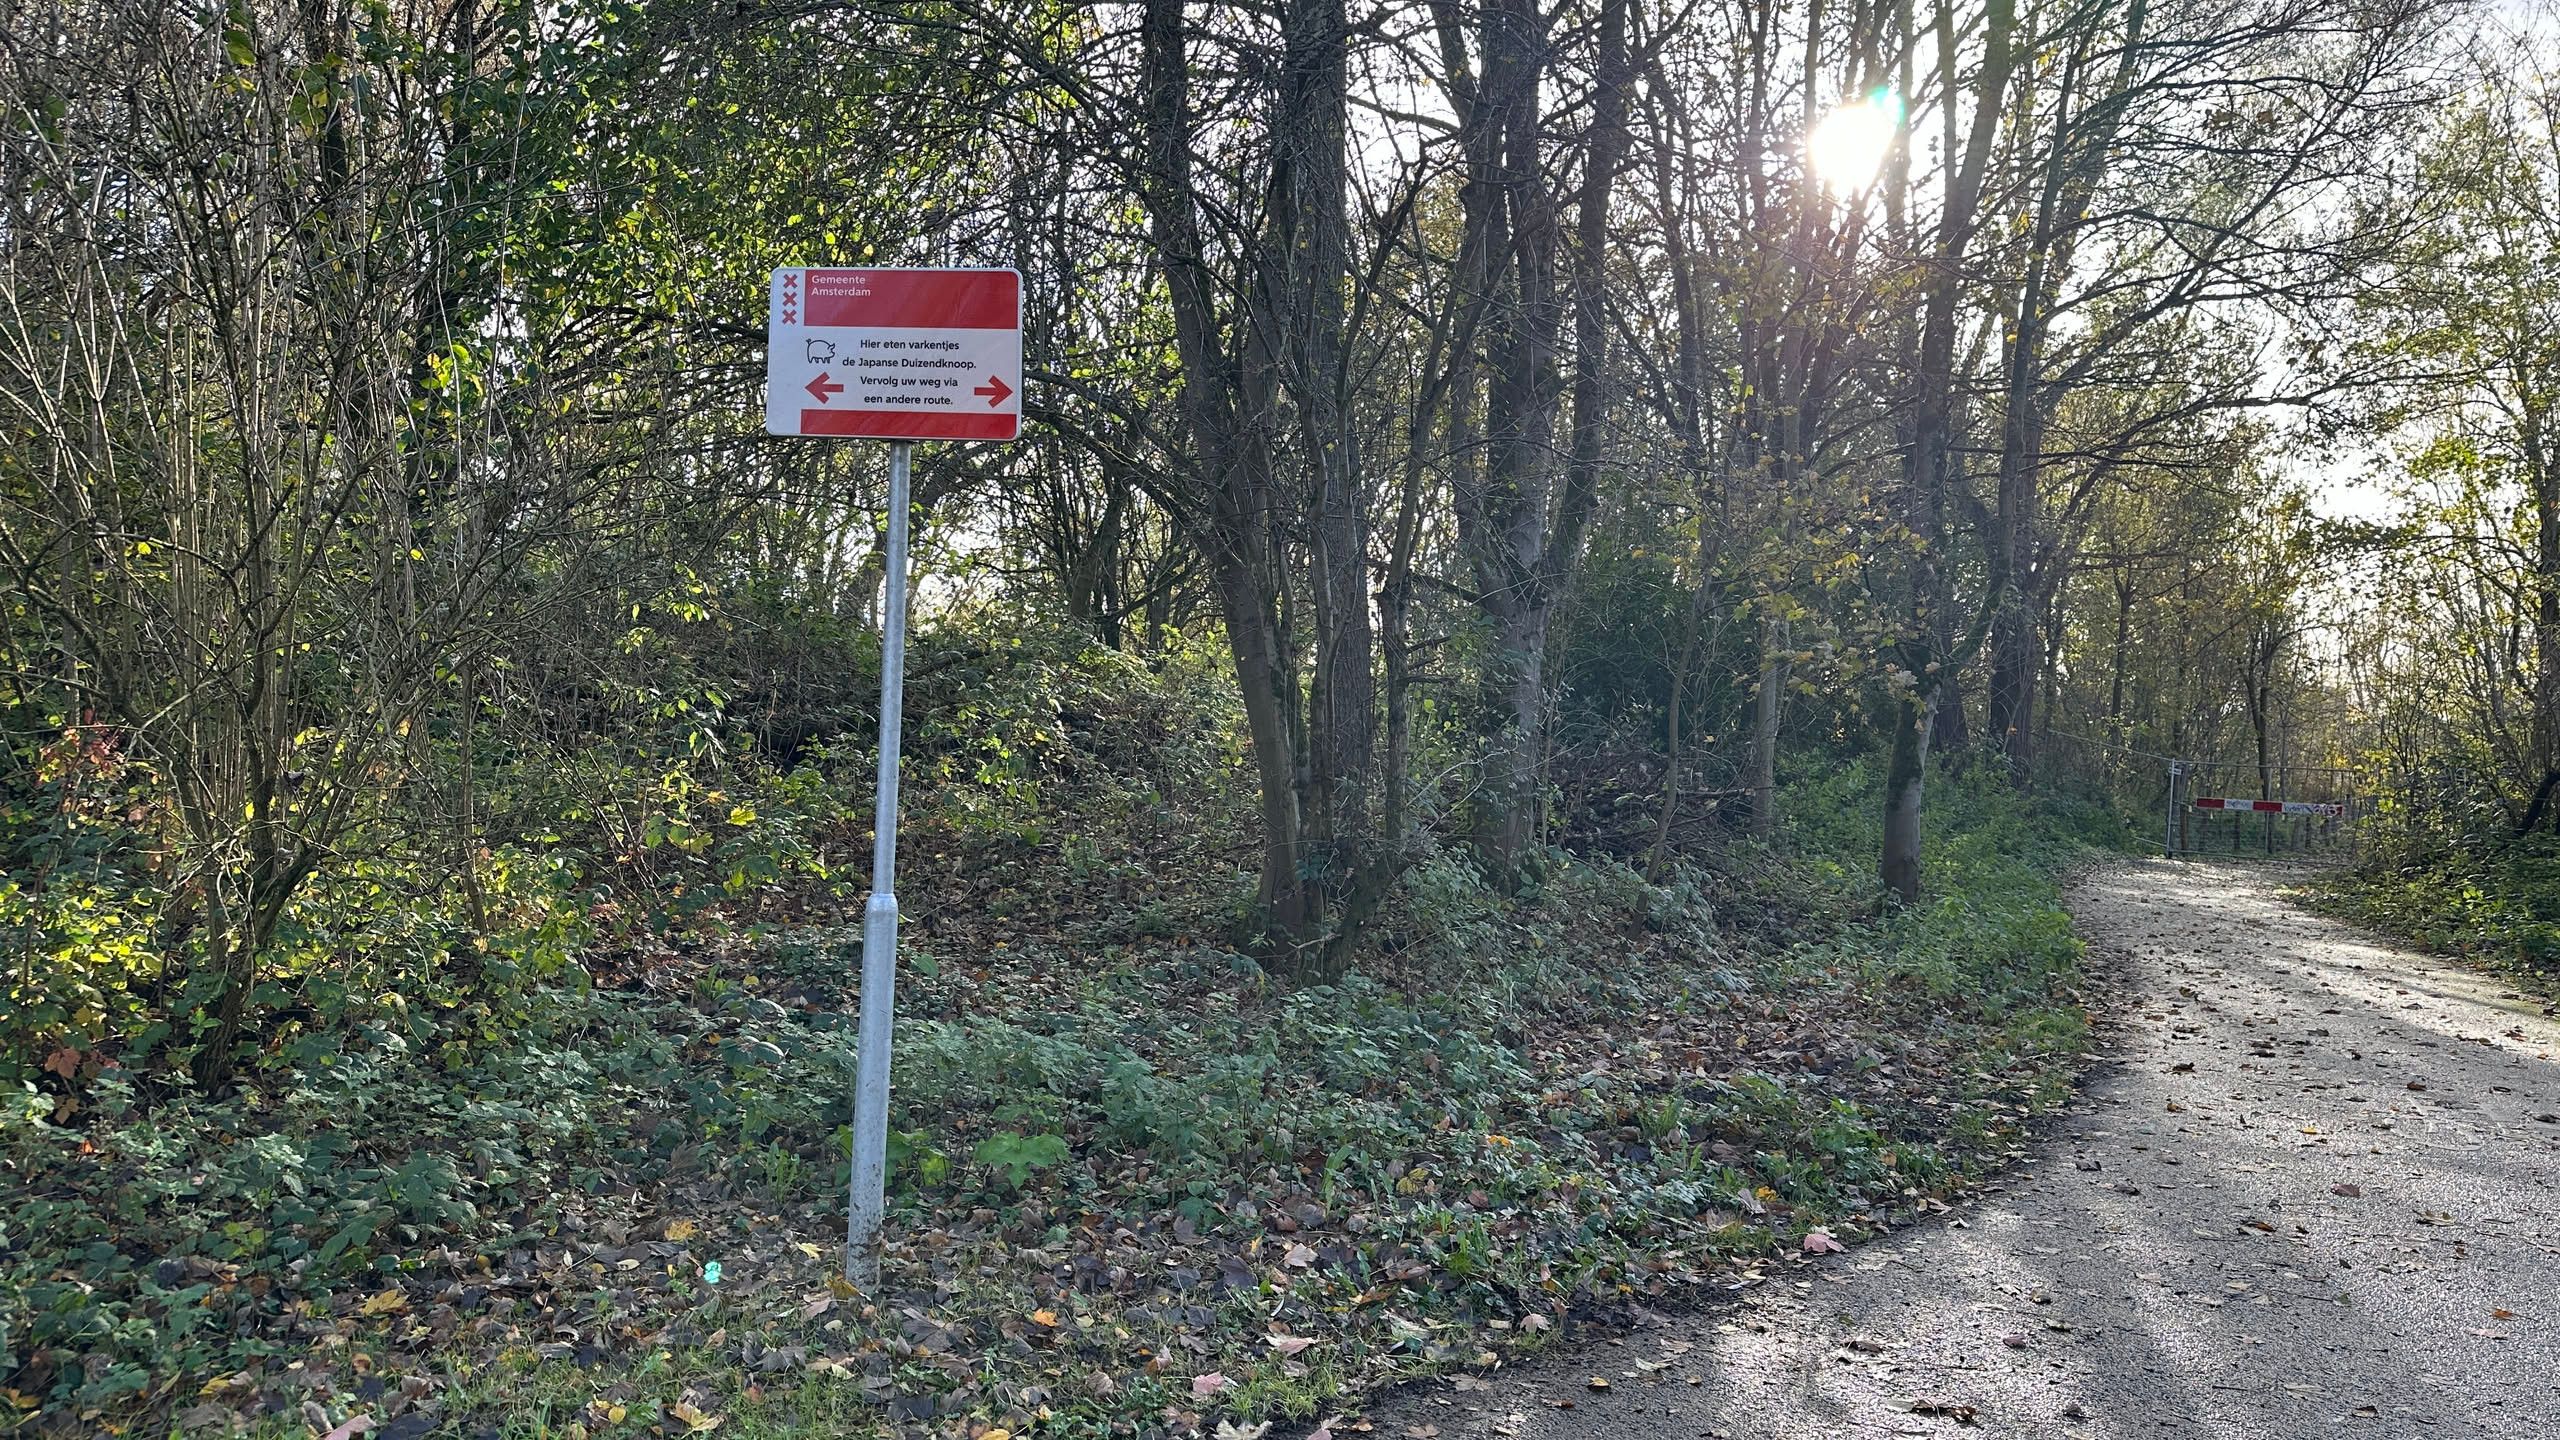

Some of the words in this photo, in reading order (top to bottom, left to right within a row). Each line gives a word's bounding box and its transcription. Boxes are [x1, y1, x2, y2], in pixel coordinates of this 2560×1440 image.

[811, 275, 866, 285] Gemeente
[811, 287, 871, 297] Amsterdam
[860, 339, 881, 349] Hier
[883, 341, 906, 349] eten
[908, 340, 960, 351] varkentjes
[842, 357, 855, 366] de
[858, 358, 899, 369] Japanse
[901, 358, 977, 371] Duizendknoop.
[860, 376, 898, 387] Vervolg
[901, 378, 916, 386] uw
[919, 378, 941, 388] weg
[944, 377, 958, 386] via
[885, 395, 921, 404] andere
[923, 396, 953, 405] route.
